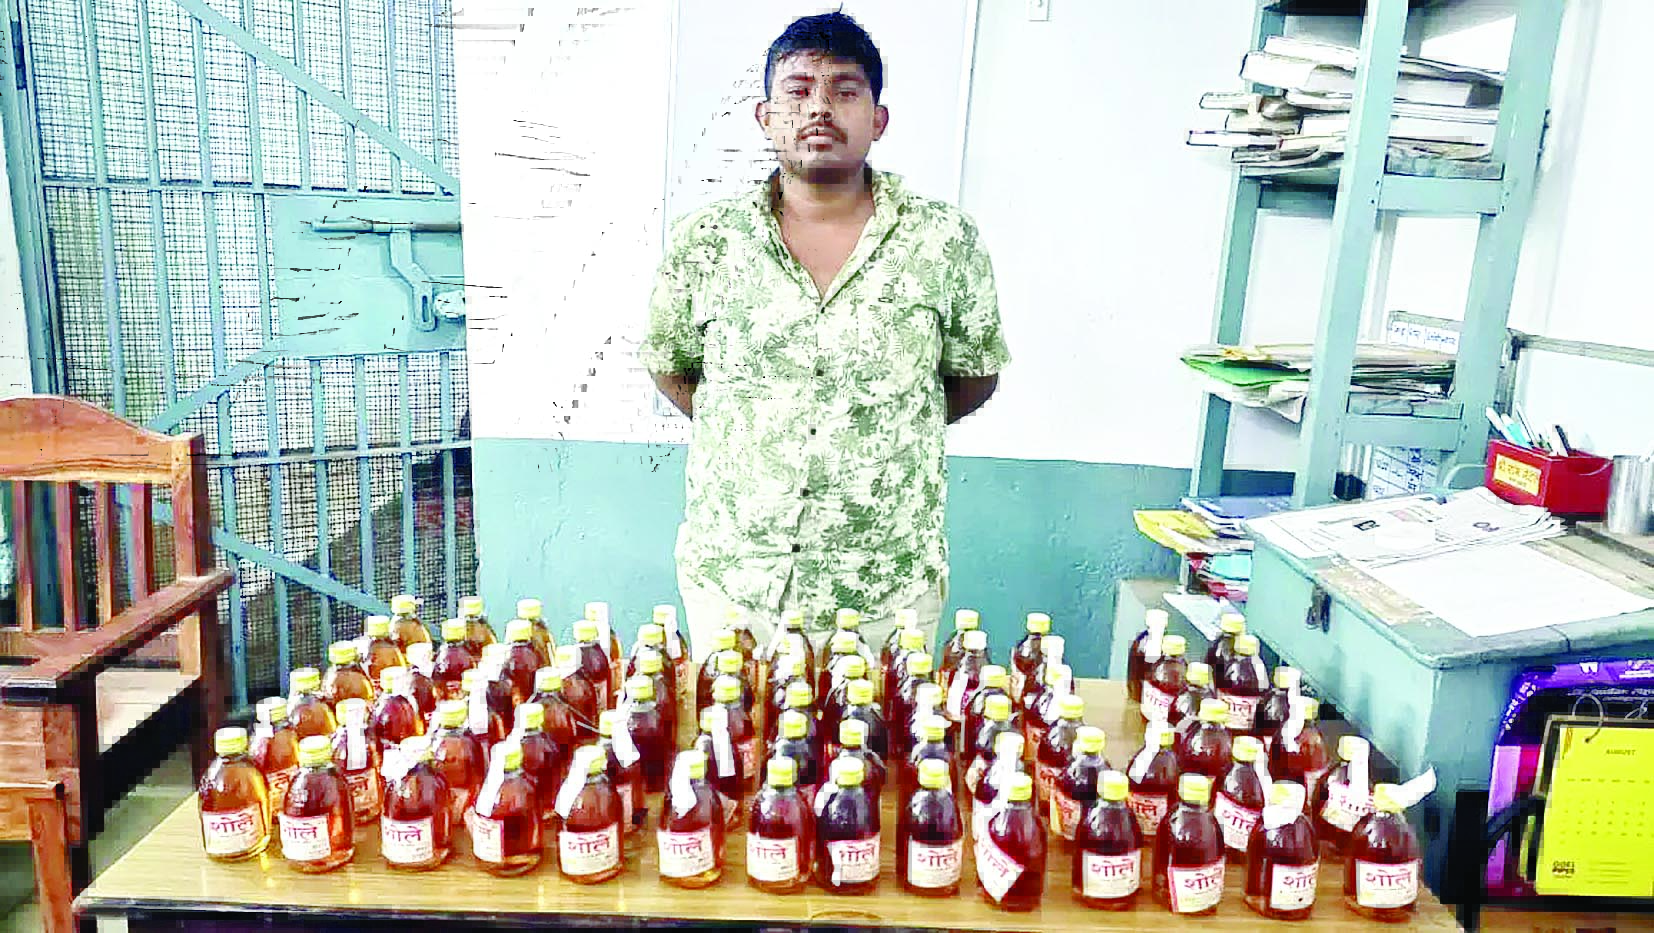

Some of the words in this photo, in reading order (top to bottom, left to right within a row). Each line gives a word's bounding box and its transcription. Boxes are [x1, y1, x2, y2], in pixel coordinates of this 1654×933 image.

[210, 812, 254, 833] शोले
[568, 833, 610, 854] शोले
[917, 849, 959, 867] शोले
[1091, 858, 1135, 877] शोले
[1366, 868, 1412, 887] शोले
